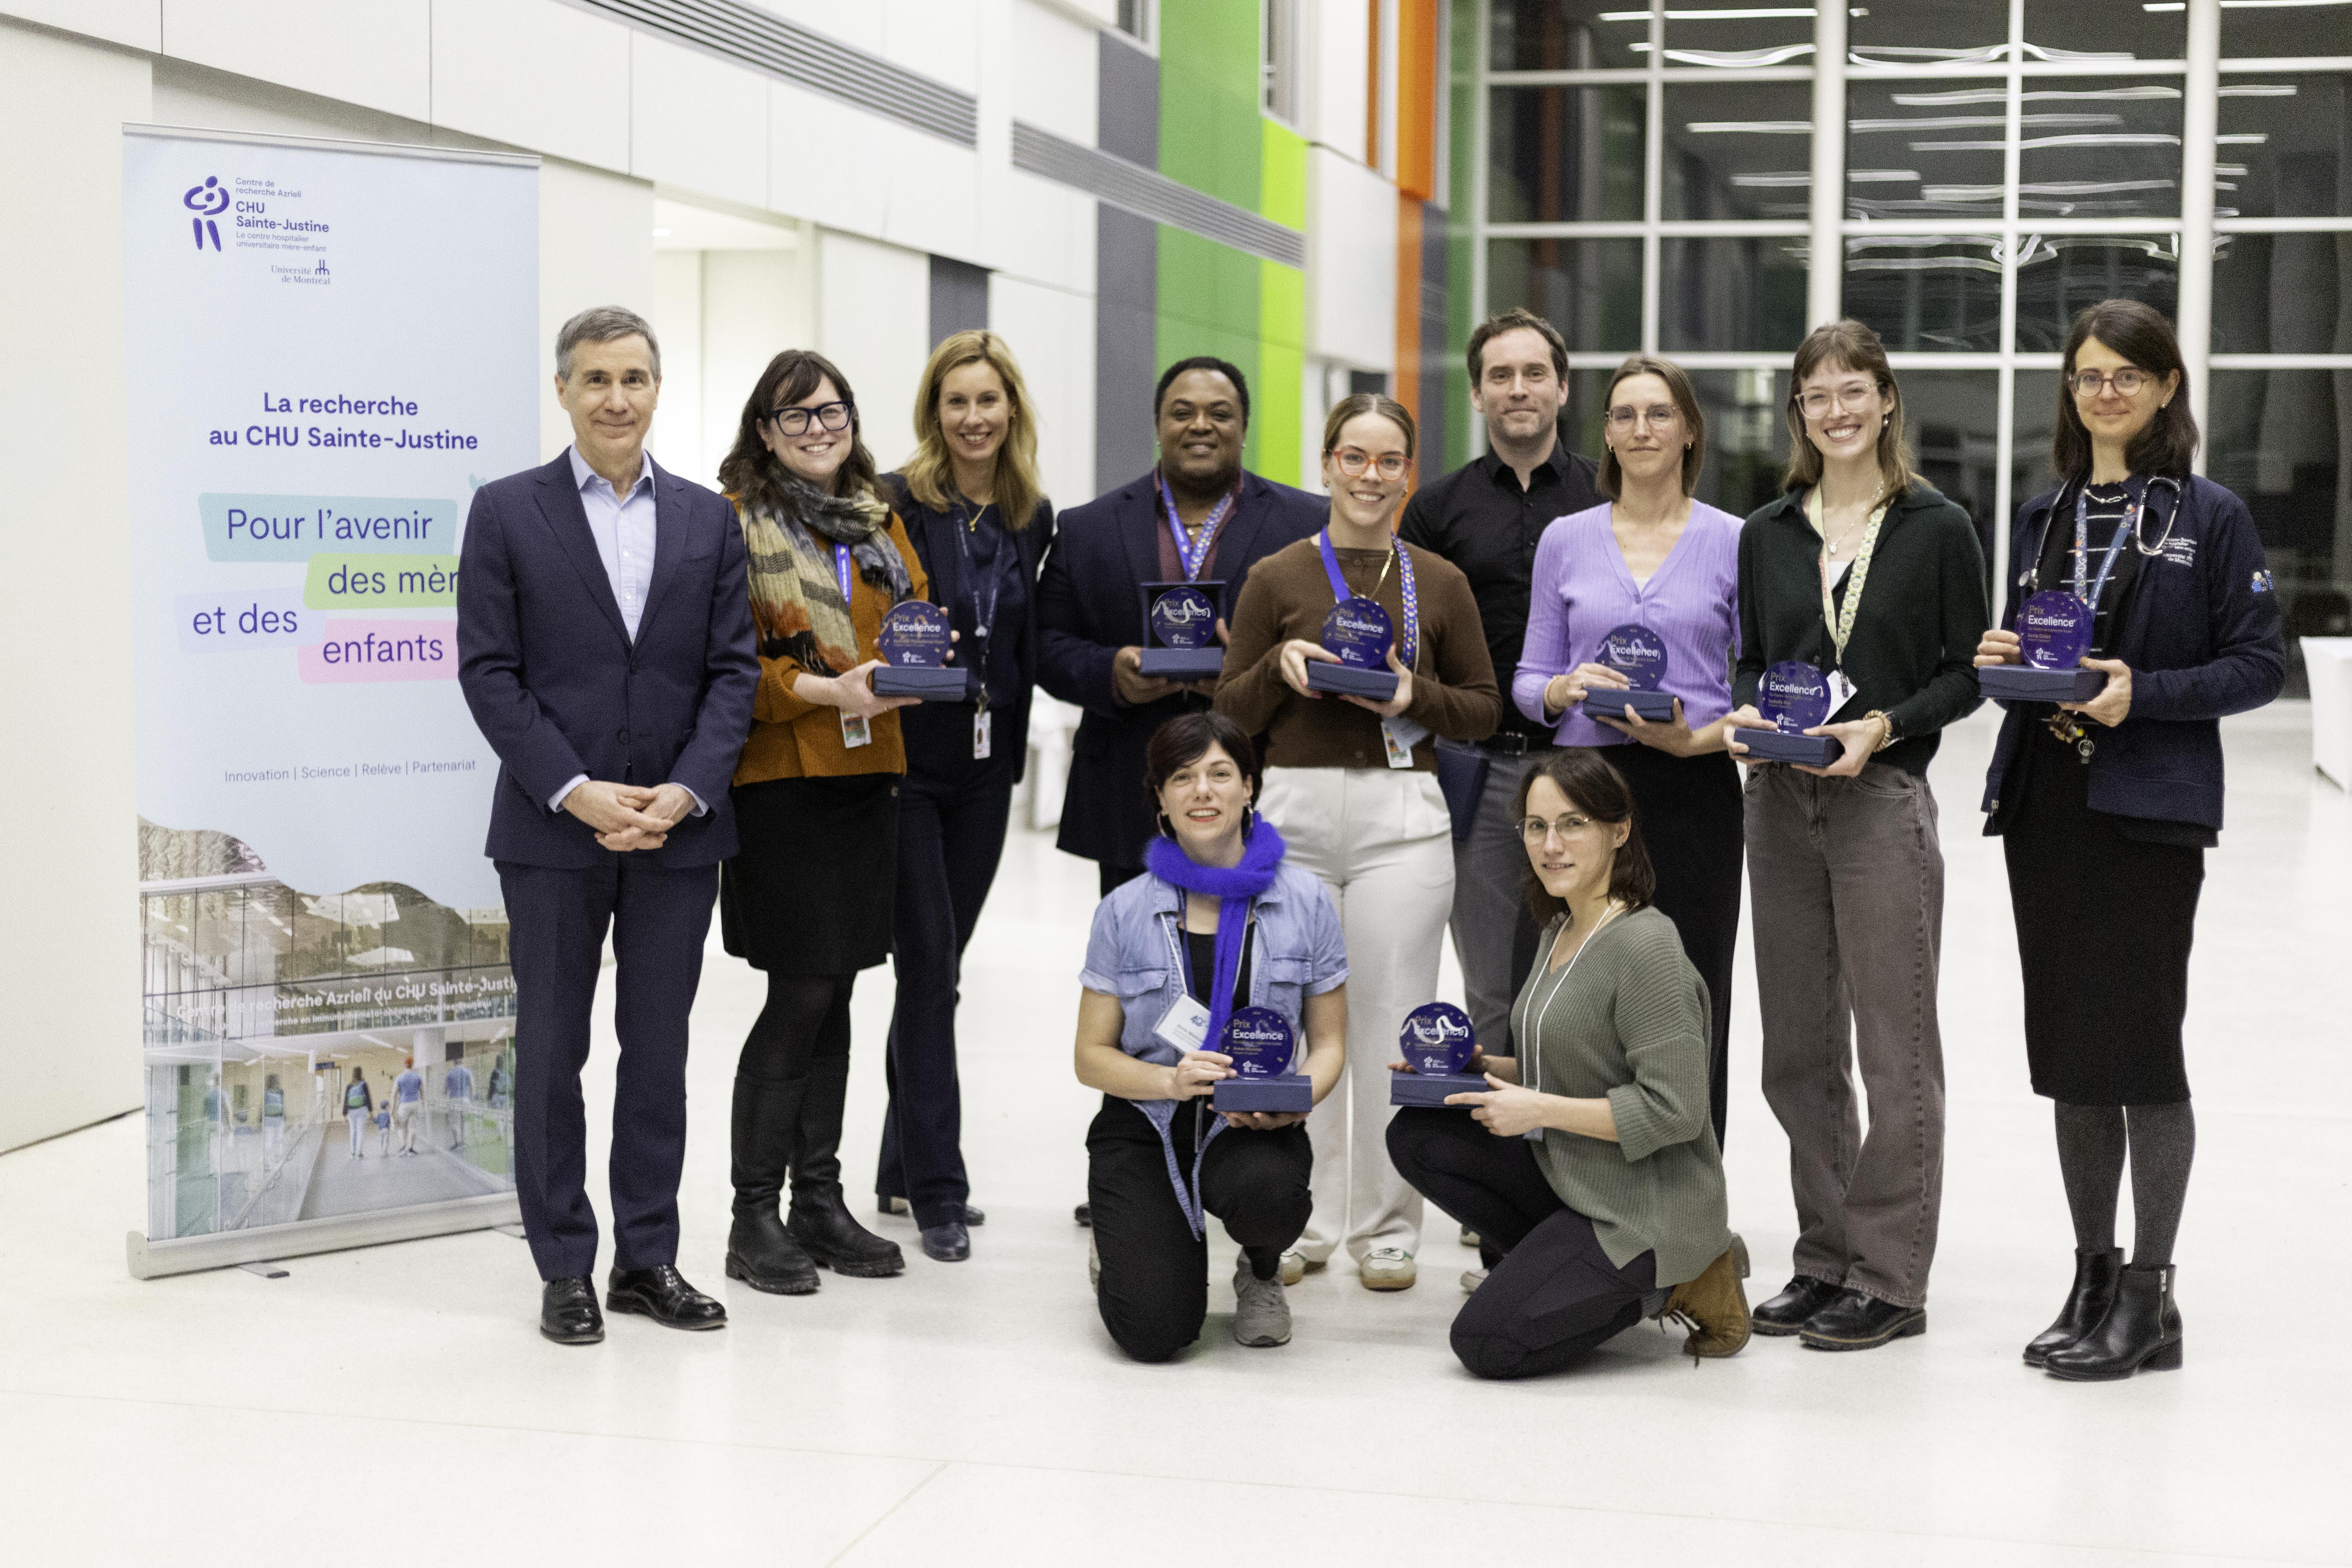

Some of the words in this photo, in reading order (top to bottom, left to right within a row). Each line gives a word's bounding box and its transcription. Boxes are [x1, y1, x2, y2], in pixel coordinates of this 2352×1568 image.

[236, 177, 263, 187] Centre
[265, 179, 274, 187] de
[236, 187, 275, 196] recherche
[278, 190, 301, 198] Azrieli
[236, 201, 265, 213] CHU
[236, 216, 329, 233] Sainte-Justine
[272, 233, 309, 243] hospitalier
[236, 241, 280, 249] universitaire
[271, 265, 311, 275] Université
[294, 276, 331, 285] Montréal
[264, 392, 292, 412] La
[300, 394, 418, 416] recherche
[209, 429, 237, 446] au
[246, 425, 299, 447] CHU
[308, 427, 478, 450] Sainte-Justine
[228, 509, 305, 540] Pour
[328, 564, 386, 594] des
[399, 564, 459, 594] mèr
[2029, 605, 2044, 614] Prix
[193, 606, 226, 634] et
[238, 602, 298, 634] des
[894, 614, 909, 622] Prix
[2028, 615, 2074, 627] Excellence
[894, 623, 941, 632] Excellence
[1336, 617, 1384, 634] Excellence
[1611, 636, 1627, 644] Prix
[323, 633, 444, 664] enfants
[1610, 644, 1658, 657] Excellence
[1770, 672, 1785, 682] Prix
[1770, 681, 1815, 695] Excellence
[225, 767, 289, 783] Innovation
[302, 765, 350, 779] Science
[362, 762, 401, 777] Relève
[413, 759, 476, 774] Partenariat
[250, 995, 323, 1012] recherche
[1233, 1019, 1251, 1029] Prix
[1233, 1029, 1283, 1040] Excellence
